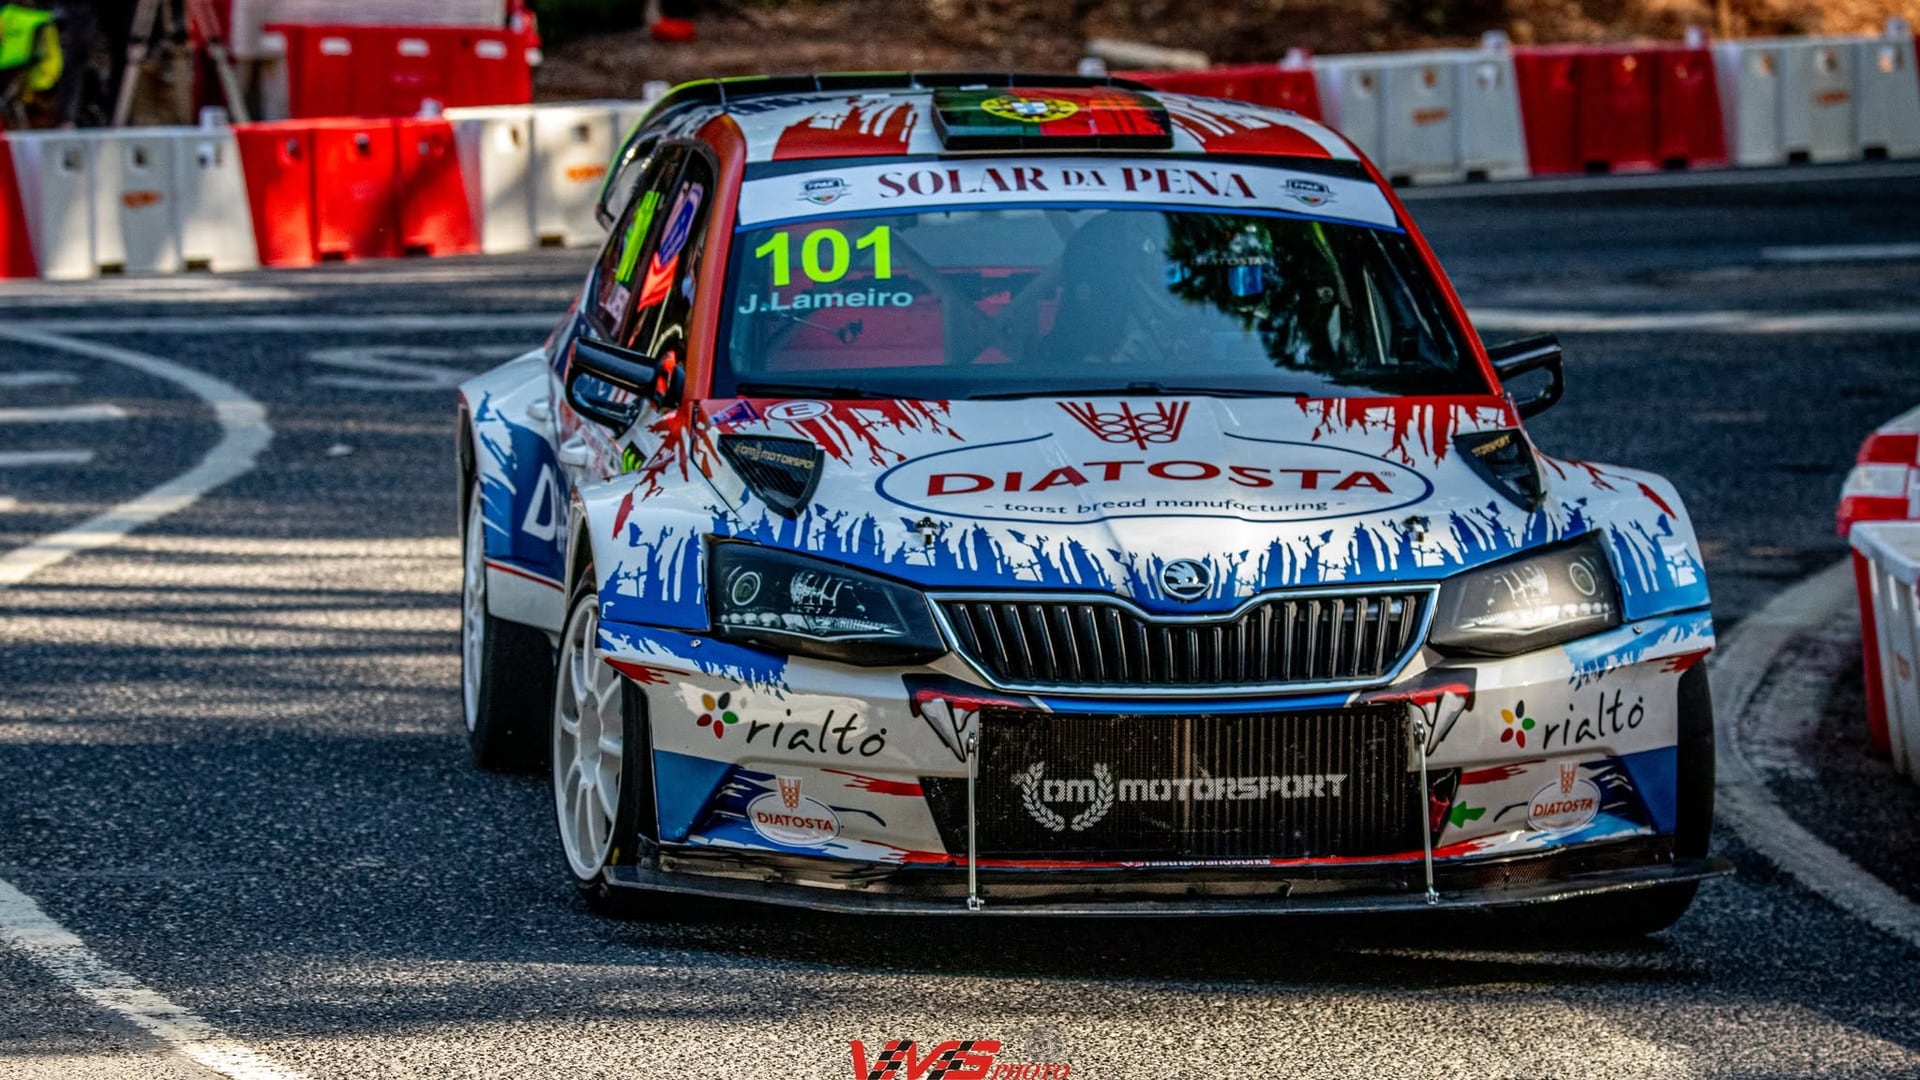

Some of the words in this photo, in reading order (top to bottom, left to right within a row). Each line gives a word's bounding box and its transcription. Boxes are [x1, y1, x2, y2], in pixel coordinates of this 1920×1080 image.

[877, 167, 1050, 198] SOLAR
[1062, 169, 1107, 187] DA
[1120, 167, 1257, 199] PENA
[755, 225, 891, 286] 101
[738, 288, 913, 314] J.Lameiro
[1004, 503, 1067, 515] toast
[1077, 498, 1147, 513] bread
[1156, 498, 1328, 513] manufacturing
[1118, 773, 1348, 802] MOTORSPORT
[1533, 797, 1594, 817] DIATOSTA
[756, 811, 834, 832] DIATOSTA
